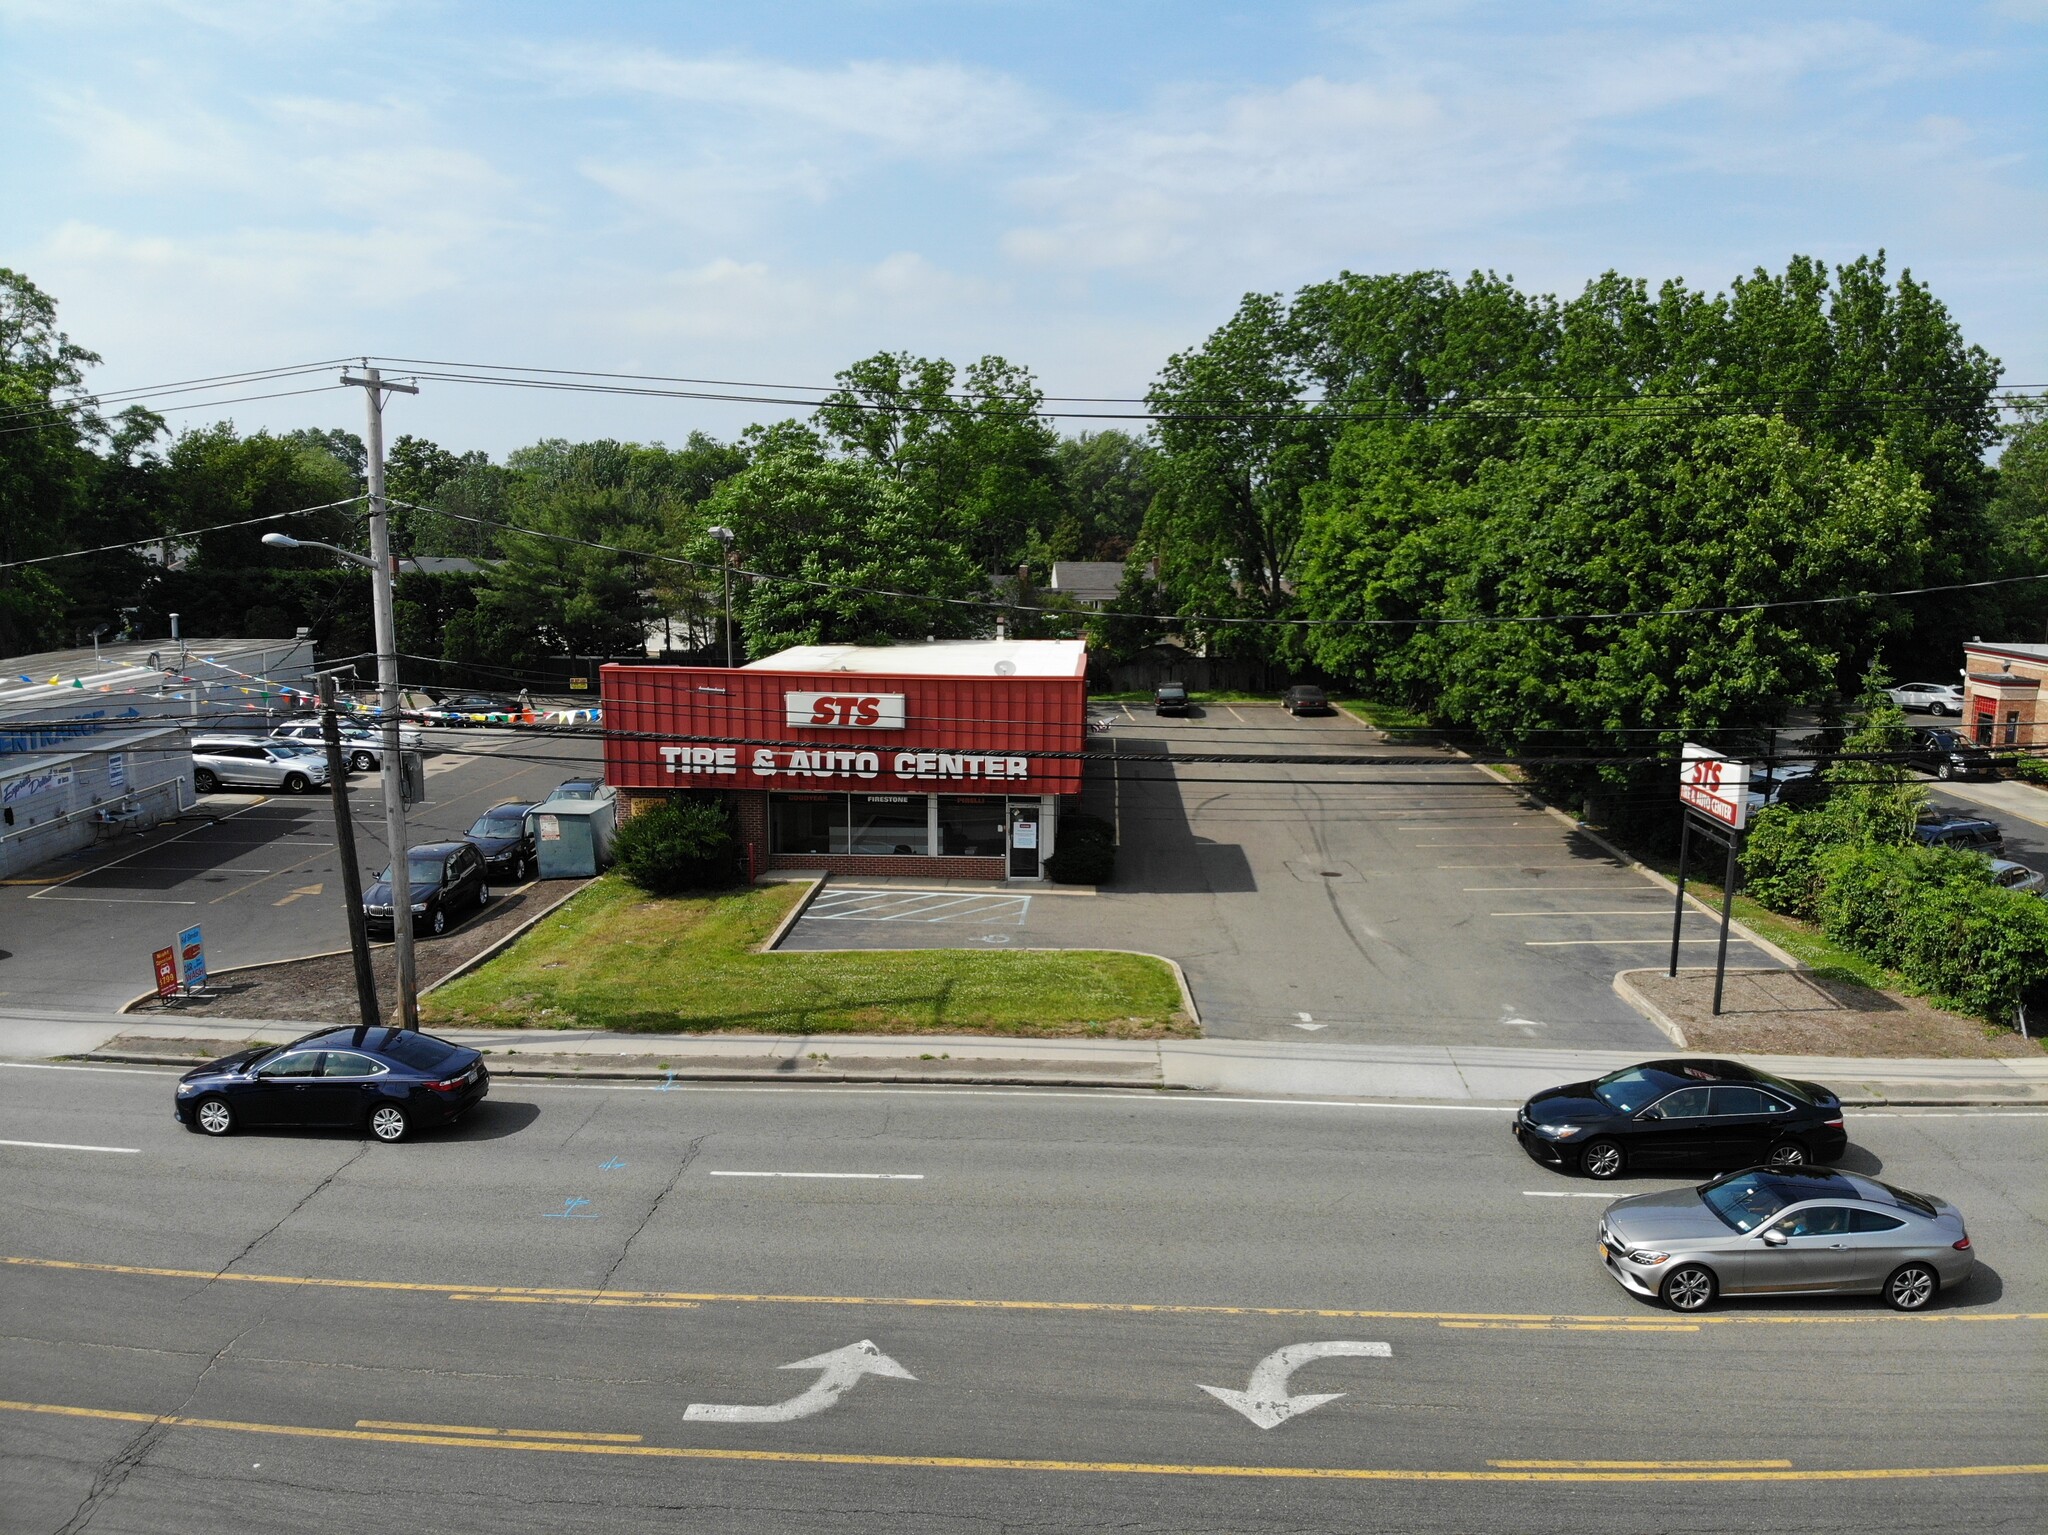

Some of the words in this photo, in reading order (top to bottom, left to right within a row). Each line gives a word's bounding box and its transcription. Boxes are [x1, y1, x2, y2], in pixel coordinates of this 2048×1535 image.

[810, 696, 881, 726] STS
[659, 746, 737, 774] TIRE
[752, 749, 777, 776] &
[787, 750, 879, 778] AUTO
[894, 752, 1028, 781] CENTER
[1692, 757, 1723, 793] STS
[867, 796, 909, 804] FIRESTONE
[1711, 799, 1732, 821] CENTER
